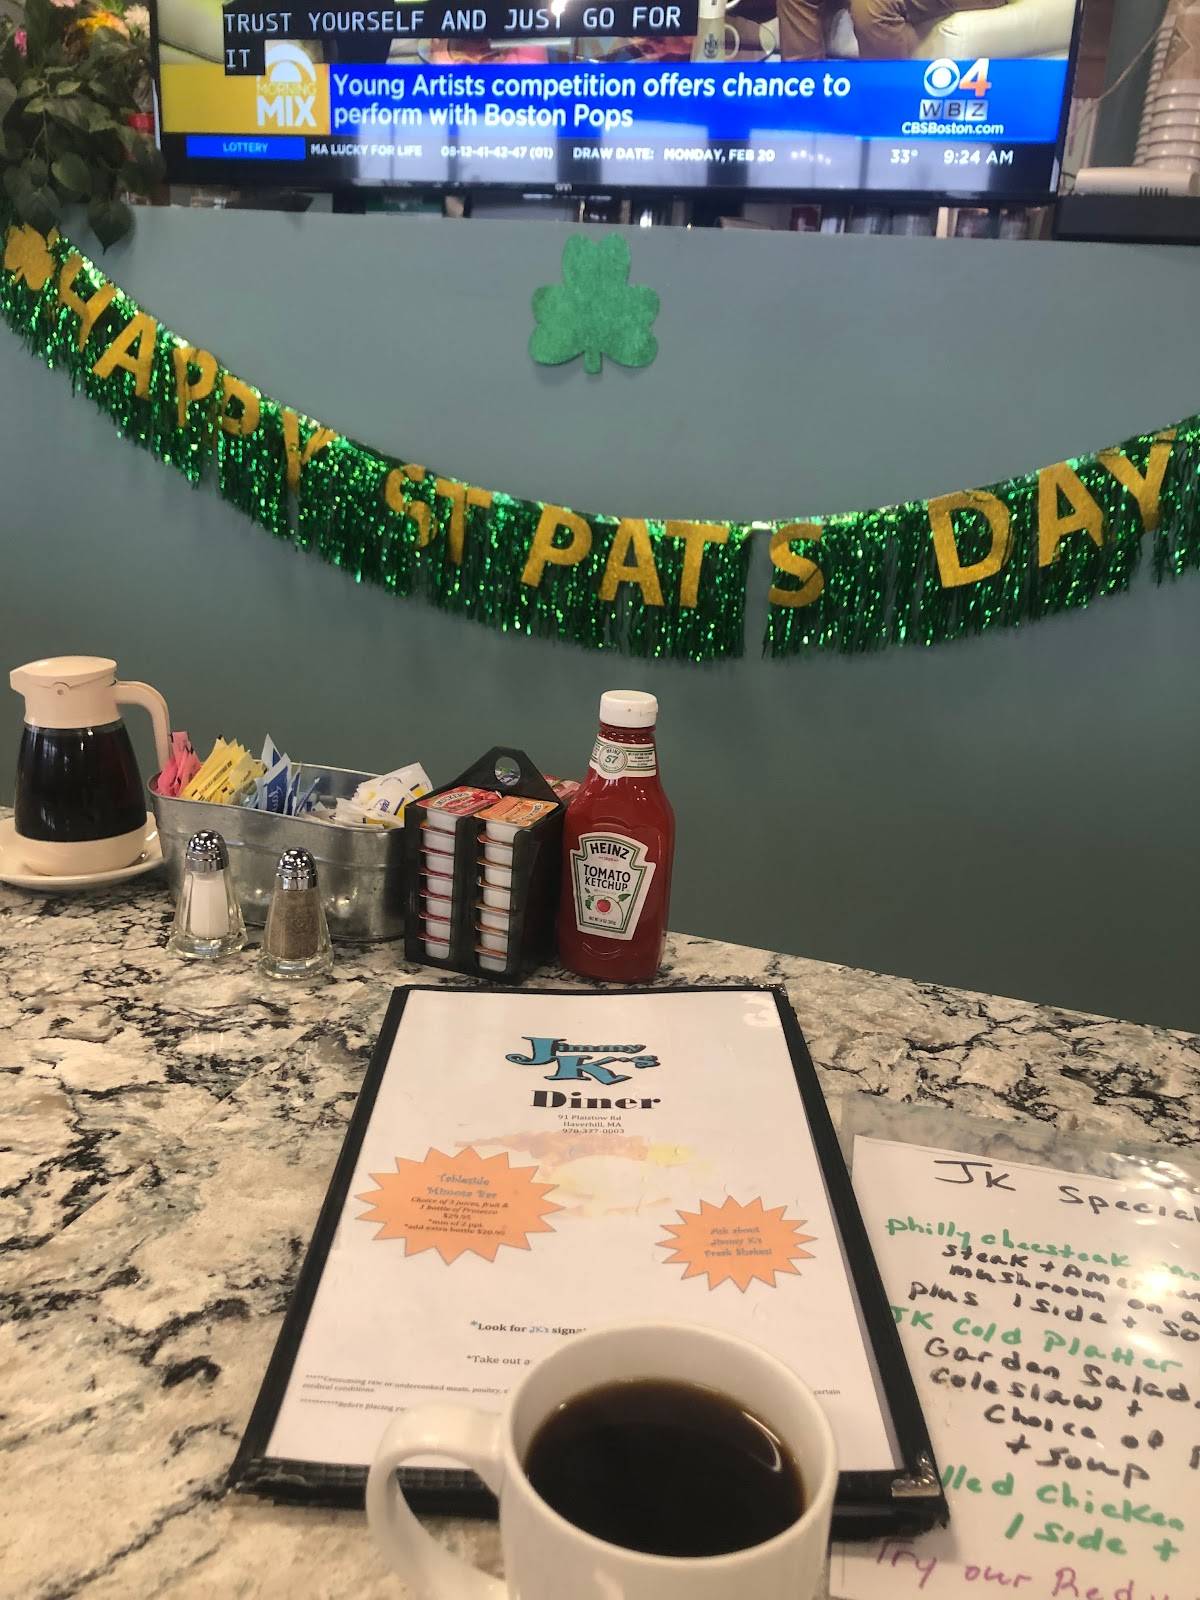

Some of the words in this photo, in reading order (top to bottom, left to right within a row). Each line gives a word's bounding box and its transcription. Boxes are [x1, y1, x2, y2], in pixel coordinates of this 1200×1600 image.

[224, 12, 292, 33] TRUST
[307, 10, 425, 33] YOURSELF
[441, 9, 487, 30] AND
[503, 8, 561, 30] JUST
[582, 7, 615, 29] GO
[632, 6, 681, 28] FOR
[226, 48, 250, 68] IT
[333, 73, 405, 99] Young
[412, 73, 486, 97] Artists
[491, 73, 636, 101] competition
[643, 71, 716, 97] offers
[722, 71, 816, 97] chance
[822, 72, 851, 97] to
[958, 57, 992, 97] 4
[256, 95, 317, 127] MIX
[334, 102, 422, 127] perform
[428, 102, 478, 127] with
[484, 103, 567, 128] Boston
[573, 103, 634, 131] Pops
[920, 100, 987, 118] WBZ
[901, 121, 1004, 136] CBSBoston.com
[222, 142, 268, 154] LOTTERY
[310, 143, 328, 155] MA
[330, 144, 368, 156] LUCKY
[370, 144, 395, 156] FOR
[397, 144, 423, 157] LIFE
[572, 147, 611, 160] DRAW
[615, 147, 655, 160] DATE:
[663, 148, 727, 162] MONDAY,
[728, 149, 755, 161] FEB
[756, 149, 776, 162] 20
[890, 149, 919, 164] 33°
[943, 149, 981, 164] 9:24
[985, 149, 1014, 164] AM
[60, 254, 338, 492] HAPPY
[385, 463, 492, 567] ST
[927, 429, 1178, 588] DAY
[604, 754, 619, 764] 57
[589, 842, 630, 860] HEINZ
[583, 863, 631, 883] TOMATO
[584, 876, 628, 892] KETCHUP
[531, 1089, 661, 1110] Diner
[933, 1160, 1017, 1191] JK
[948, 1263, 1106, 1303] mushroom
[1127, 1298, 1164, 1314] on
[509, 1323, 528, 1333] for
[889, 1305, 934, 1330] JK
[952, 1316, 1022, 1346] Cold
[502, 1357, 522, 1366] out
[924, 1336, 1060, 1380] Garden
[984, 1403, 1097, 1440] Choice
[876, 1538, 938, 1589] Try
[964, 1564, 1033, 1588] our
